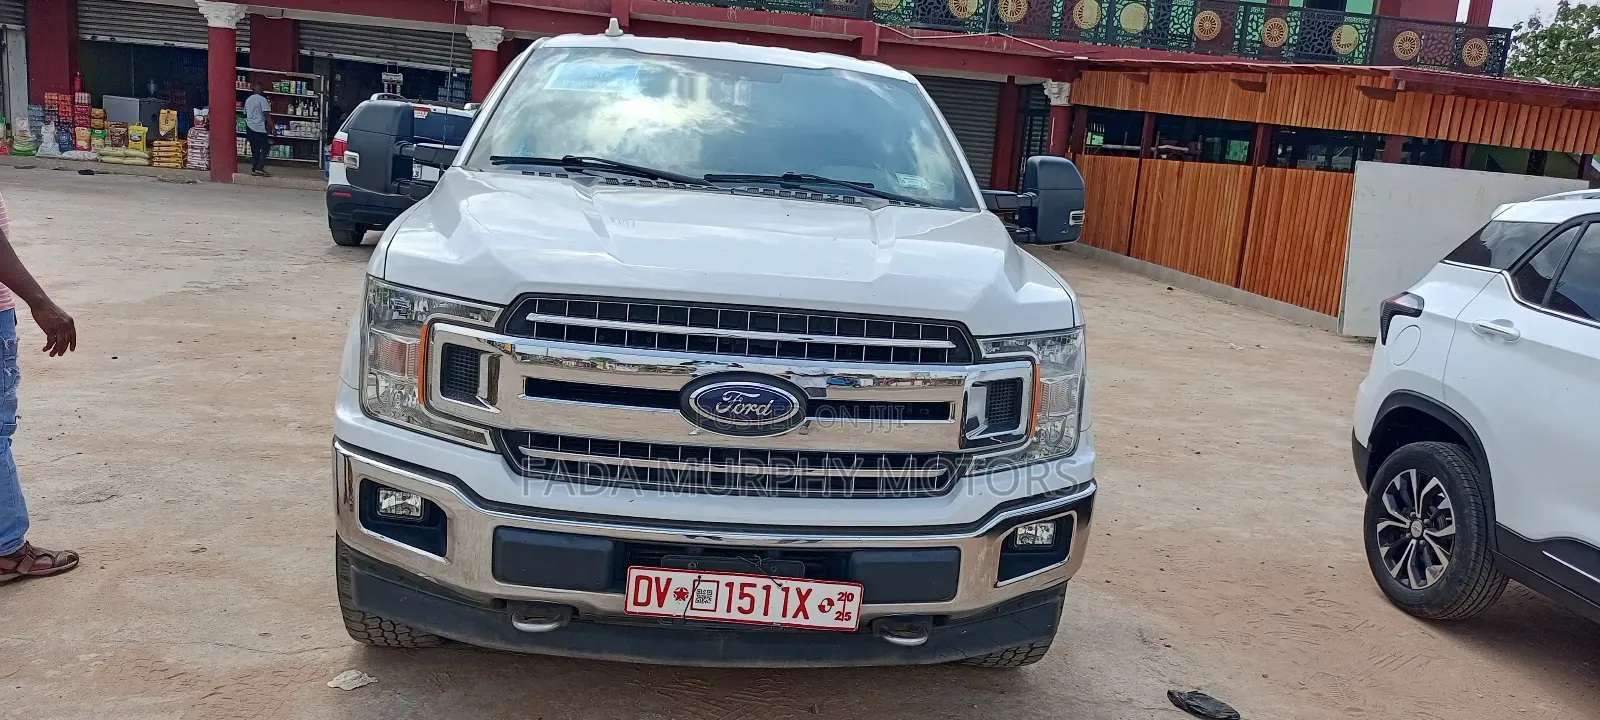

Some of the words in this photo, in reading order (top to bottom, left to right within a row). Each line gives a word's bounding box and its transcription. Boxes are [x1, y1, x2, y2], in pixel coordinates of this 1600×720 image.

[716, 391, 775, 416] Ford
[633, 575, 672, 608] DV
[725, 581, 813, 620] 1511X
[837, 591, 855, 602] 20
[834, 611, 852, 621] 25
